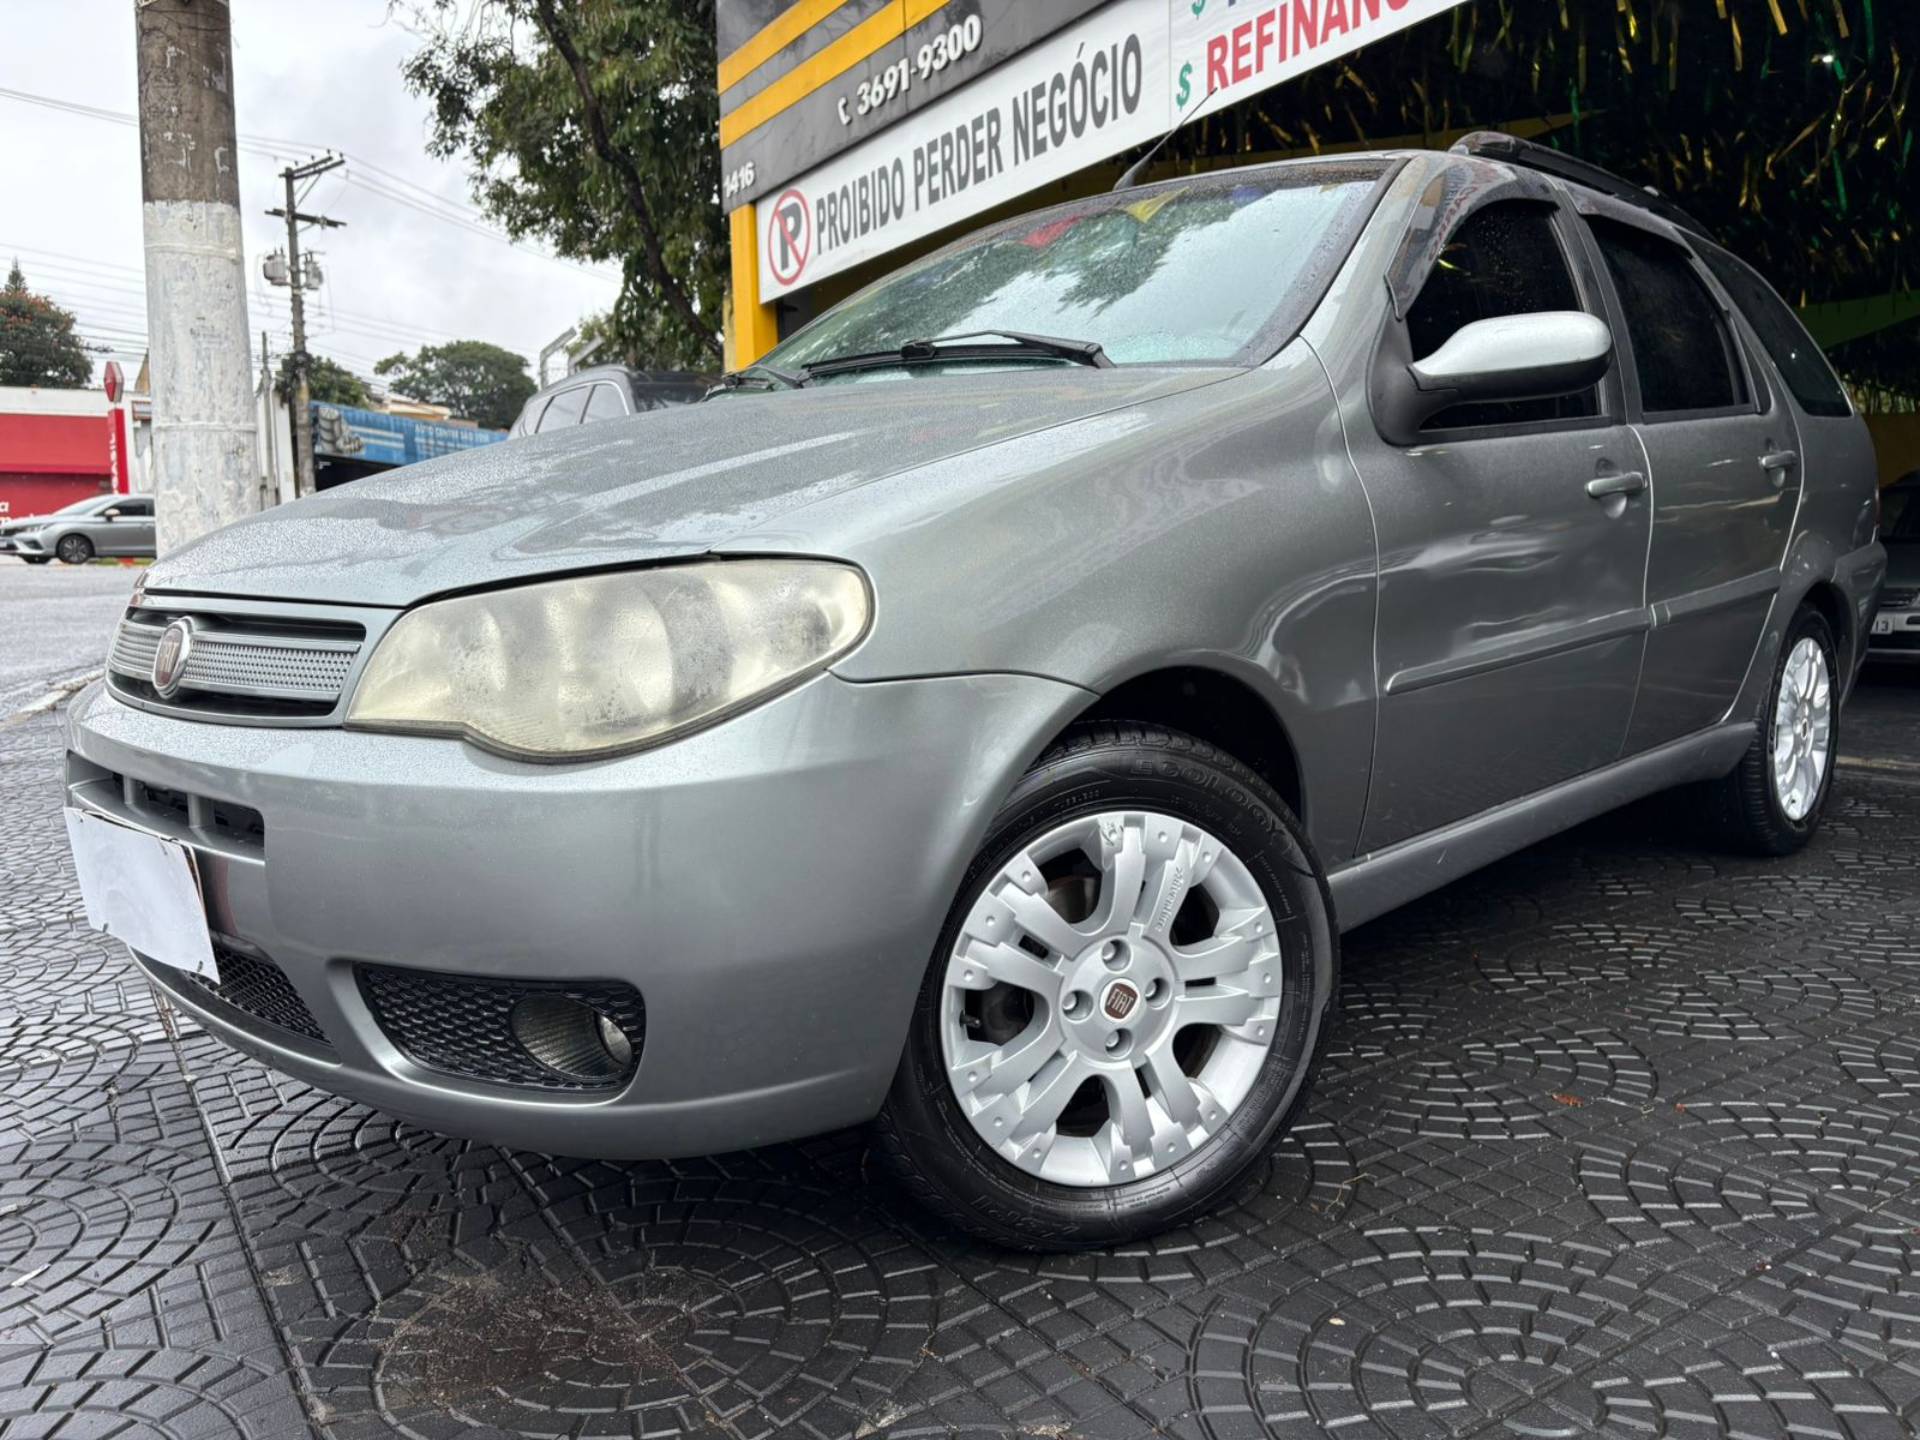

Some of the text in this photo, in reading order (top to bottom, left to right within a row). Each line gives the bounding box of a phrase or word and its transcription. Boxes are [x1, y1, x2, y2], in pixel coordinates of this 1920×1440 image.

[857, 14, 981, 115] 3691-9300
[816, 33, 1142, 255] PROIBIDO PERDER NEGÓCIO
[723, 161, 755, 198] 1416
[1108, 988, 1135, 1015] FIAT
